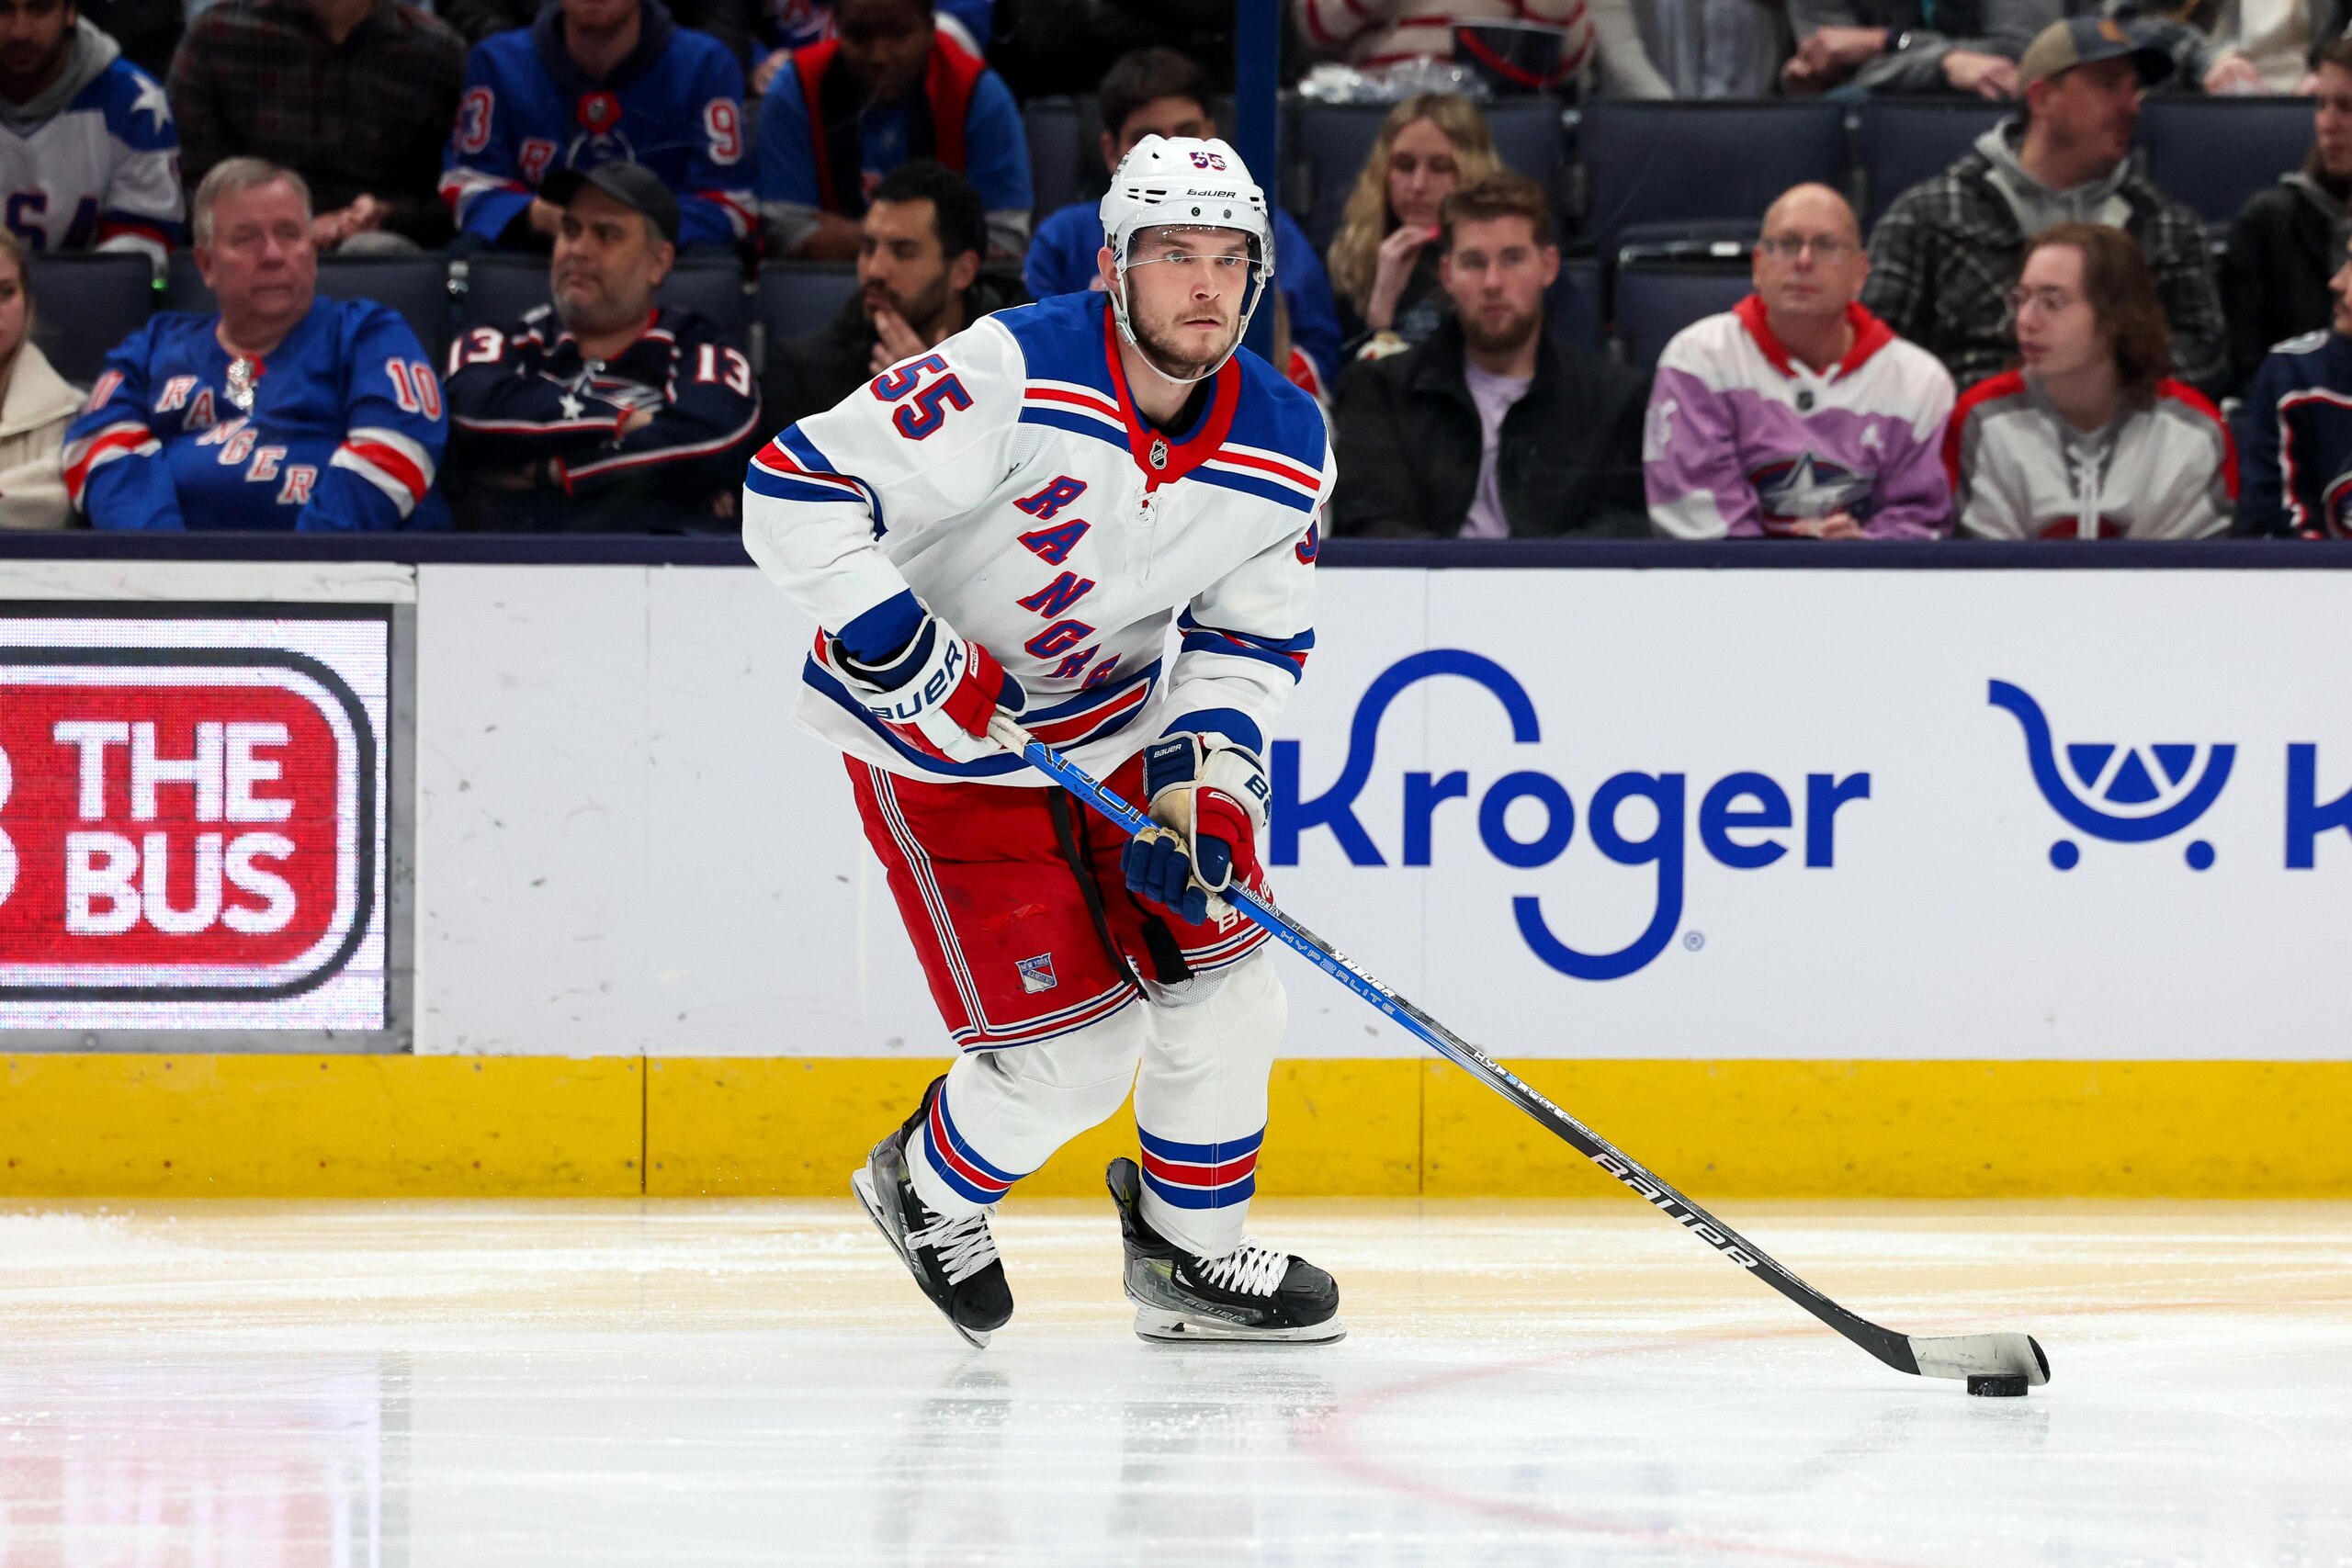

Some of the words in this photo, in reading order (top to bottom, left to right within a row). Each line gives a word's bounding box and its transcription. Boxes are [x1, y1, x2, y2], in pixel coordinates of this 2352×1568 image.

[454, 85, 494, 155] 3
[1190, 152, 1227, 172] 55
[386, 357, 443, 423] 10
[694, 343, 752, 398] 13
[869, 354, 975, 441] 55
[869, 639, 963, 720] AUER
[53, 720, 296, 823] THE
[1269, 649, 1871, 981] Kroger
[65, 830, 297, 935] BUS
[1239, 885, 1283, 918] LINDGREN
[899, 1212, 922, 1274] BAER
